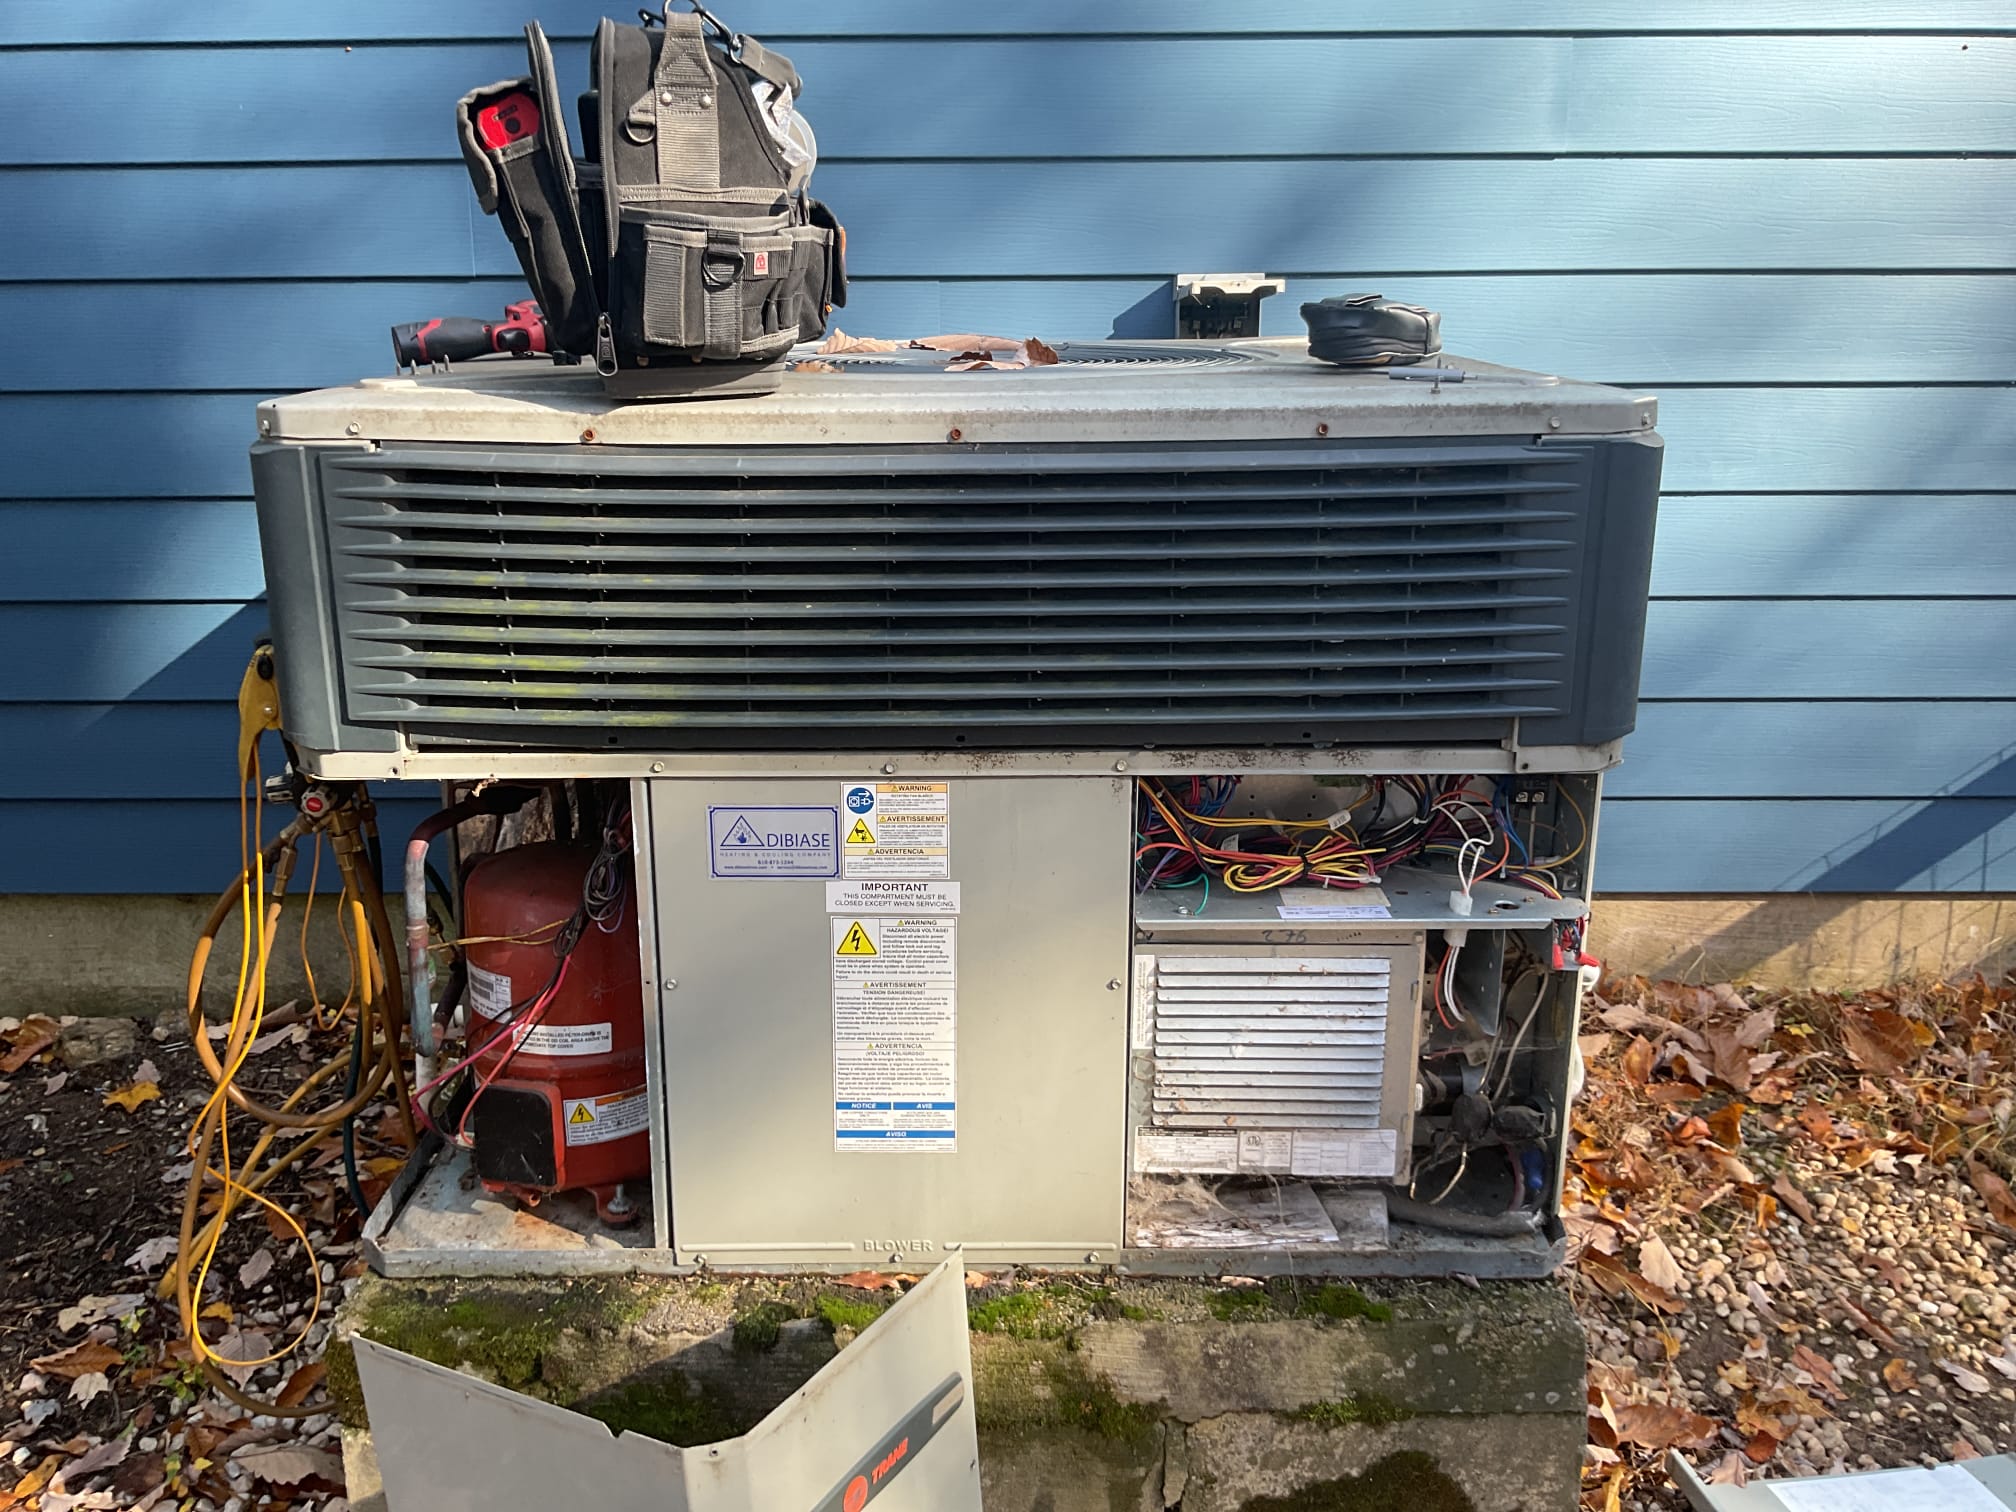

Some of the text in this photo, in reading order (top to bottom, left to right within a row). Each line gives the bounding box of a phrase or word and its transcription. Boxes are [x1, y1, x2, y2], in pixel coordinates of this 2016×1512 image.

[767, 833, 830, 847] DIBIASE
[861, 883, 928, 891] IMPORTANT
[864, 1240, 933, 1251] BLOWER
